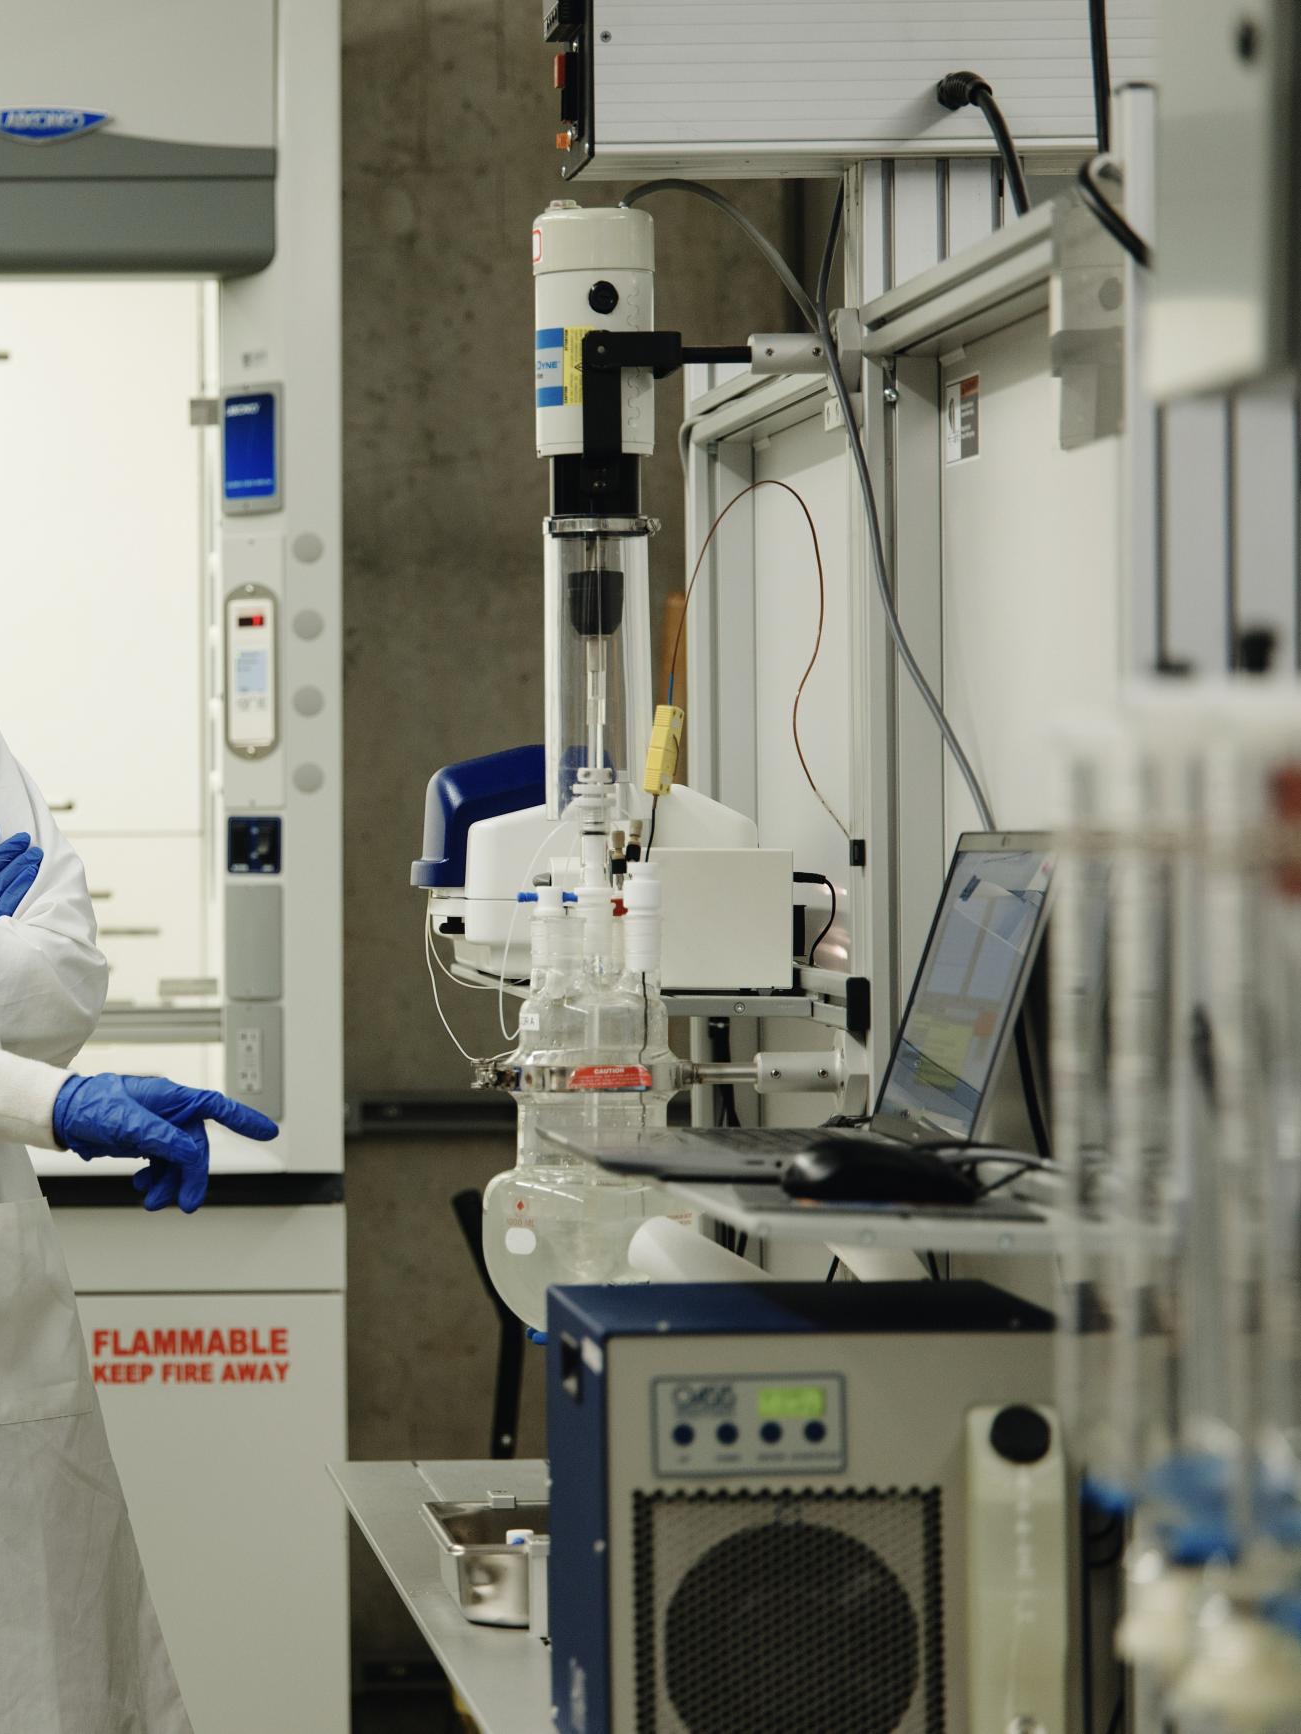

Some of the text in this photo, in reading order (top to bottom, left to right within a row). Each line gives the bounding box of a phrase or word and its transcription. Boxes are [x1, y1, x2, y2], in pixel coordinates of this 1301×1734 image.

[93, 1328, 288, 1356] FLAMMABLE
[93, 1362, 290, 1384] KEEP FIRE AWAY
